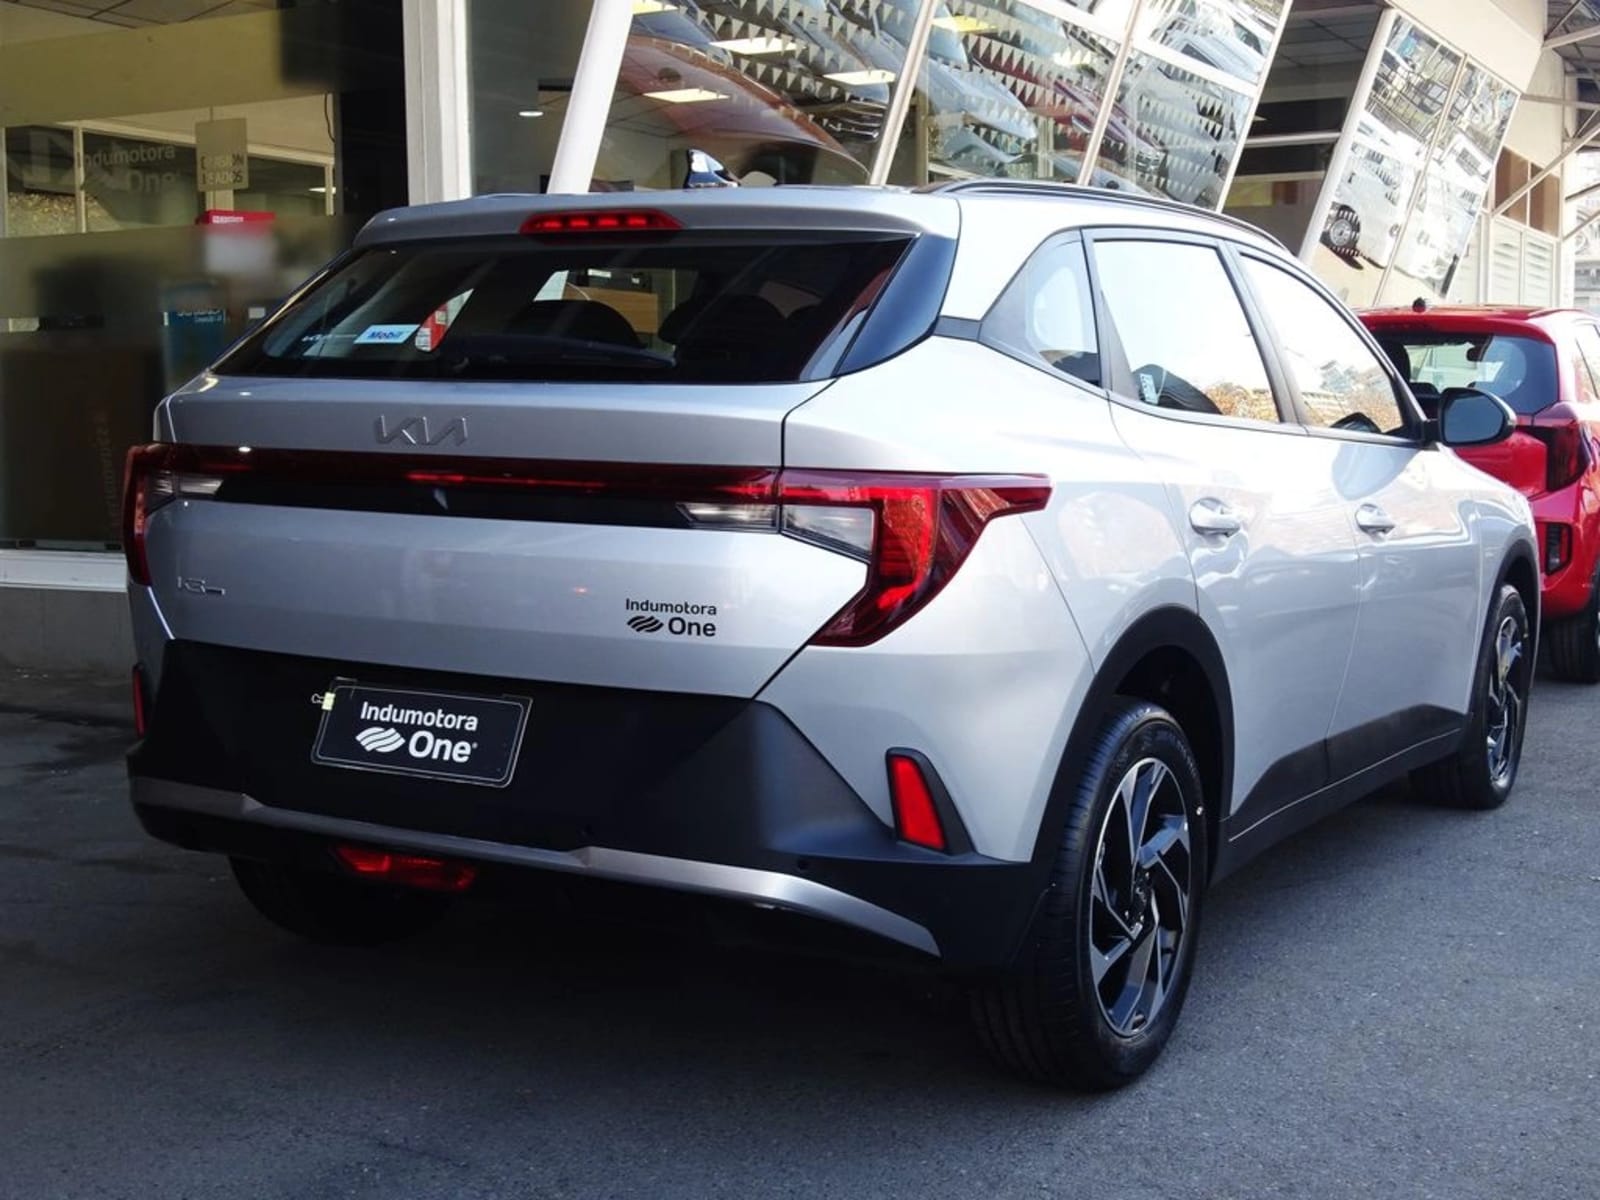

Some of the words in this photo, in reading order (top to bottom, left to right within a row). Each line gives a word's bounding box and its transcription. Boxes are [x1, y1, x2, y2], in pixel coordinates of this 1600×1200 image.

[373, 414, 468, 446] KIA
[625, 598, 717, 615] Indumotora
[668, 616, 717, 637] One
[360, 701, 478, 731] Indumotora
[408, 730, 472, 763] One
